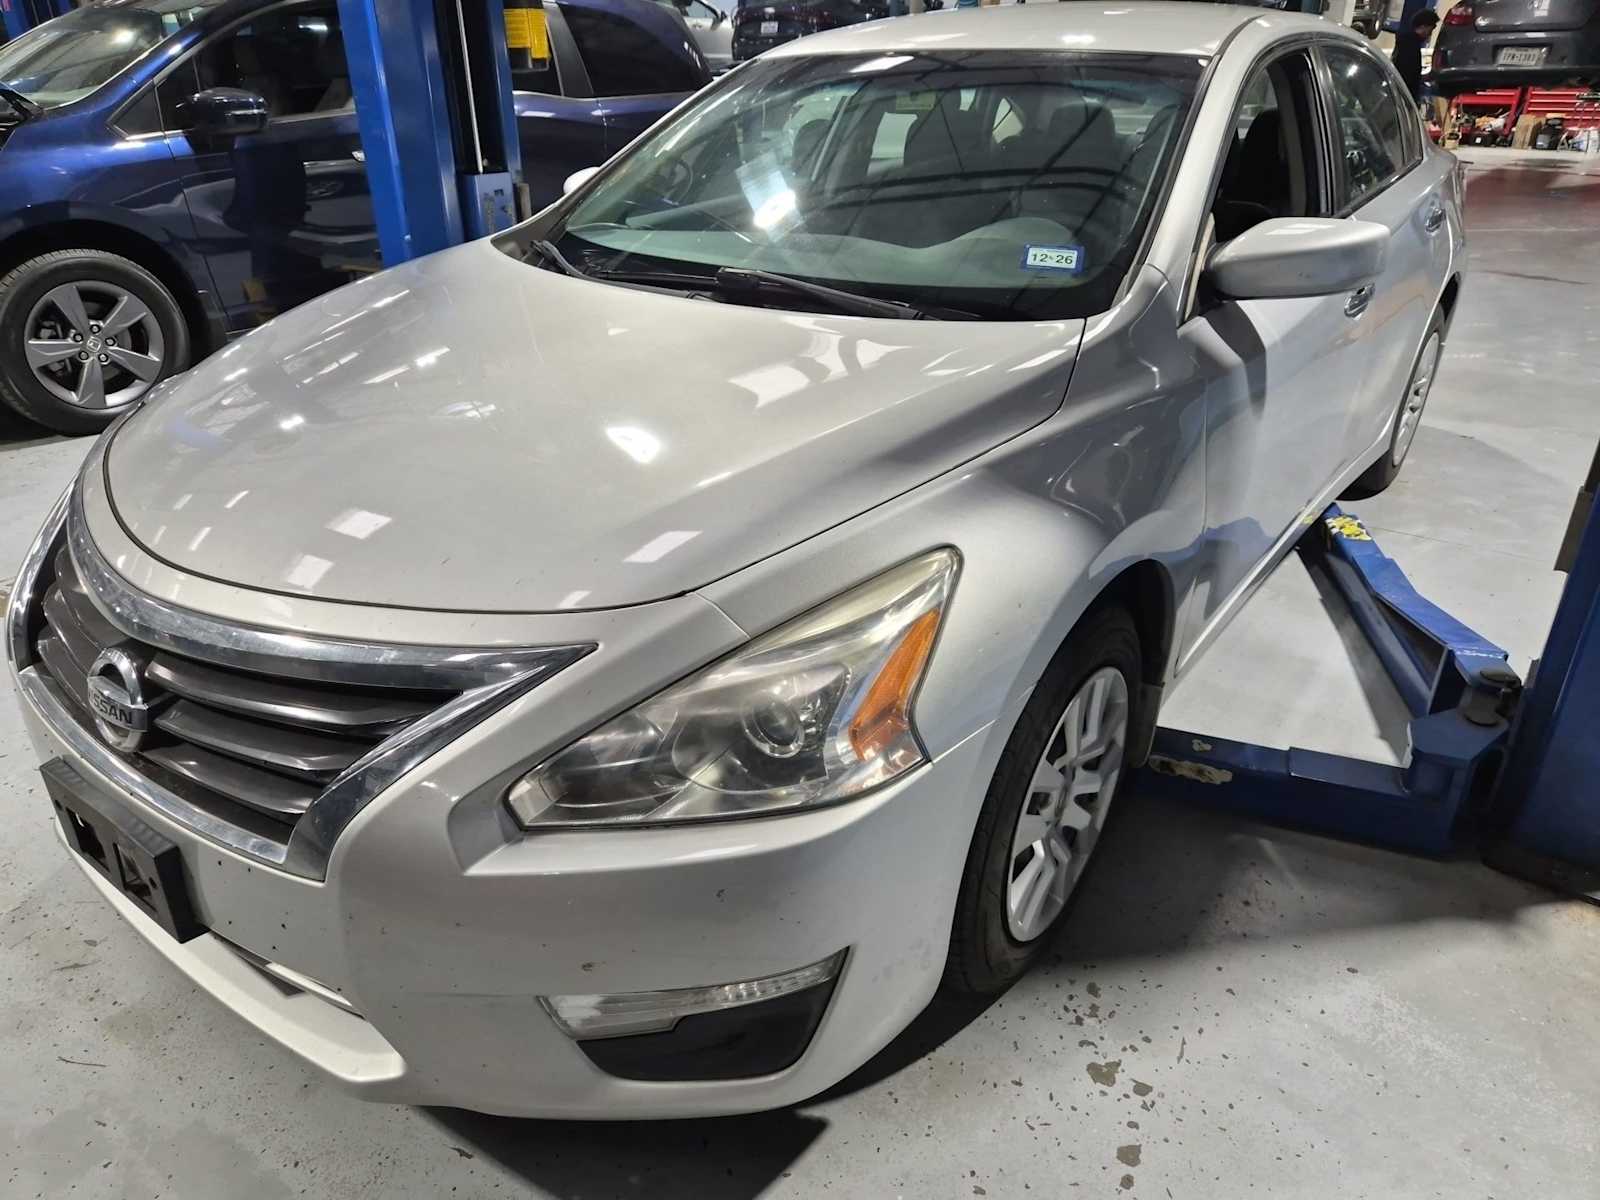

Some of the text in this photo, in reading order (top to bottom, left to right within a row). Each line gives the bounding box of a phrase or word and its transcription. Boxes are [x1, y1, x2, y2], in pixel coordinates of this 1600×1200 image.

[1032, 253, 1073, 265] 12 26
[88, 686, 132, 724] SSAN
